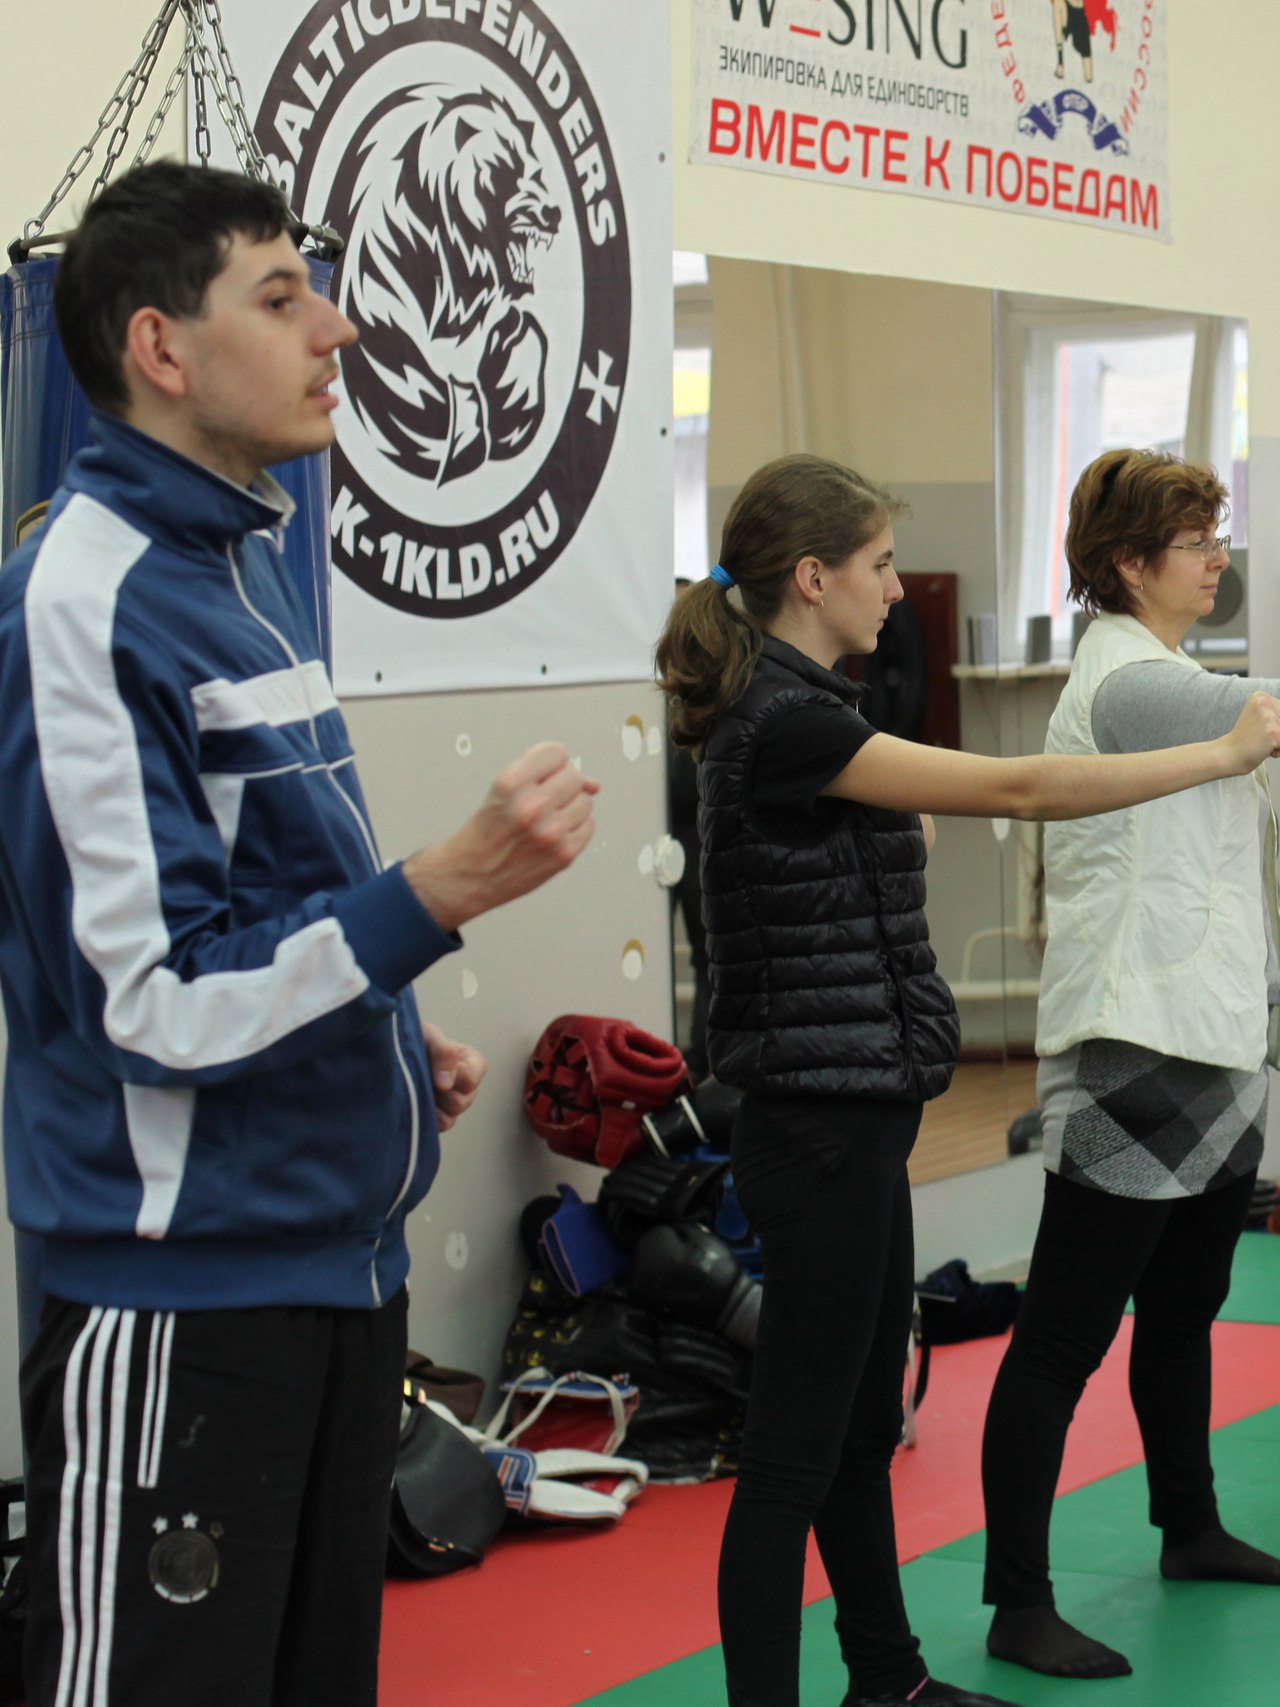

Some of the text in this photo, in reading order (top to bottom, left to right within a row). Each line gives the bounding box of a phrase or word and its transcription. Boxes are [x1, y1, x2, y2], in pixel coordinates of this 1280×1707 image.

[719, 46, 968, 117] ЭКИПИРОВКА ДЛЯ ЕДИНОБОРСТВ
[708, 98, 1160, 231] ВМЕСТЕ К ПОБЕДАМ
[330, 484, 560, 600] K-1KLD.RU
